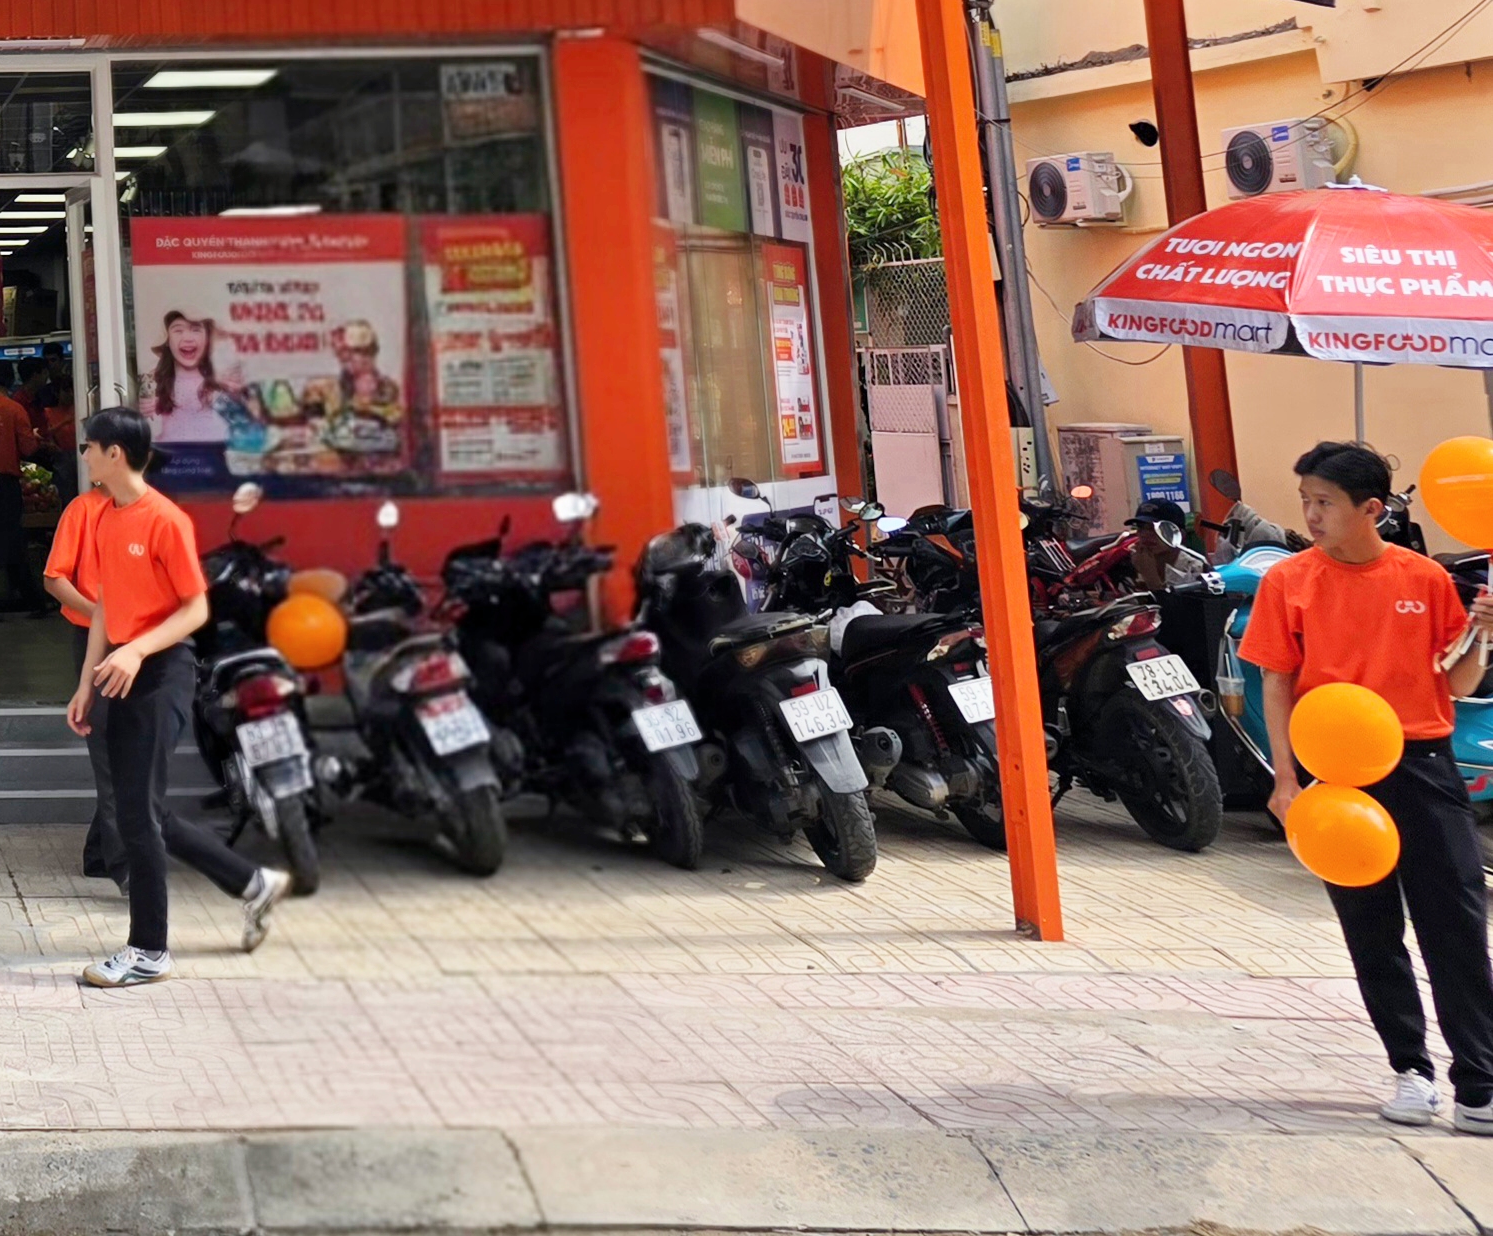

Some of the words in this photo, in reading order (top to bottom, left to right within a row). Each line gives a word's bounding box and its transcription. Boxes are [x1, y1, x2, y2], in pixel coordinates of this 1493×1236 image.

[1227, 240, 1303, 261] NGON
[1340, 244, 1402, 265] SIÊU
[1405, 248, 1457, 270] THỊ
[1135, 258, 1200, 283] CHẤT
[1317, 274, 1396, 297] THỰC
[1399, 272, 1493, 298] PHẨM
[790, 694, 834, 718] 59-U2
[793, 711, 847, 738] 146.34
